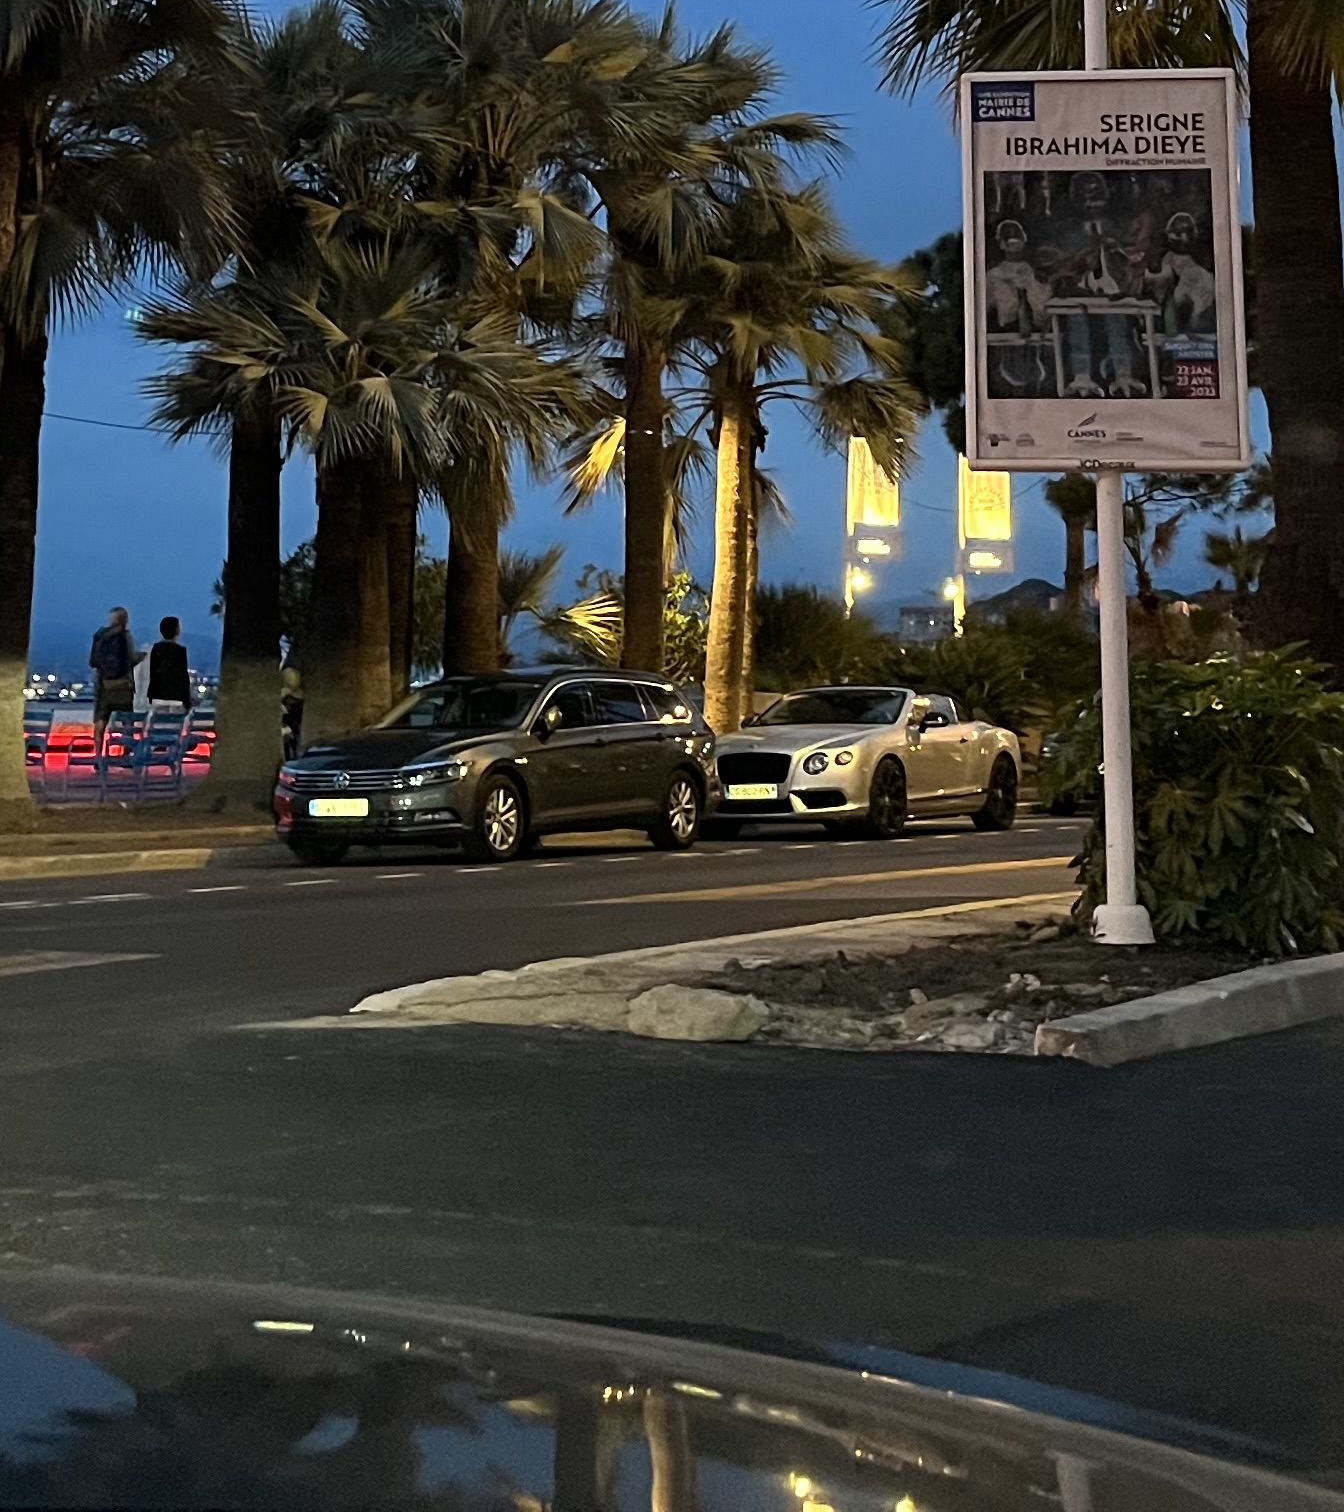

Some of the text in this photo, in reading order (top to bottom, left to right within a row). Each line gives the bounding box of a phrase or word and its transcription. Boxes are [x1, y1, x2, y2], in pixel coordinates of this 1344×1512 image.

[978, 97, 1030, 107] MAIRIE DE
[978, 107, 1031, 118] CANNES
[1100, 113, 1205, 133] SERIGNE
[1006, 135, 1206, 156] IBRAHIMA DIEYE
[1190, 387, 1216, 397] 2023
[1067, 429, 1107, 438] CANNES
[1076, 459, 1136, 469] JCDecaux
